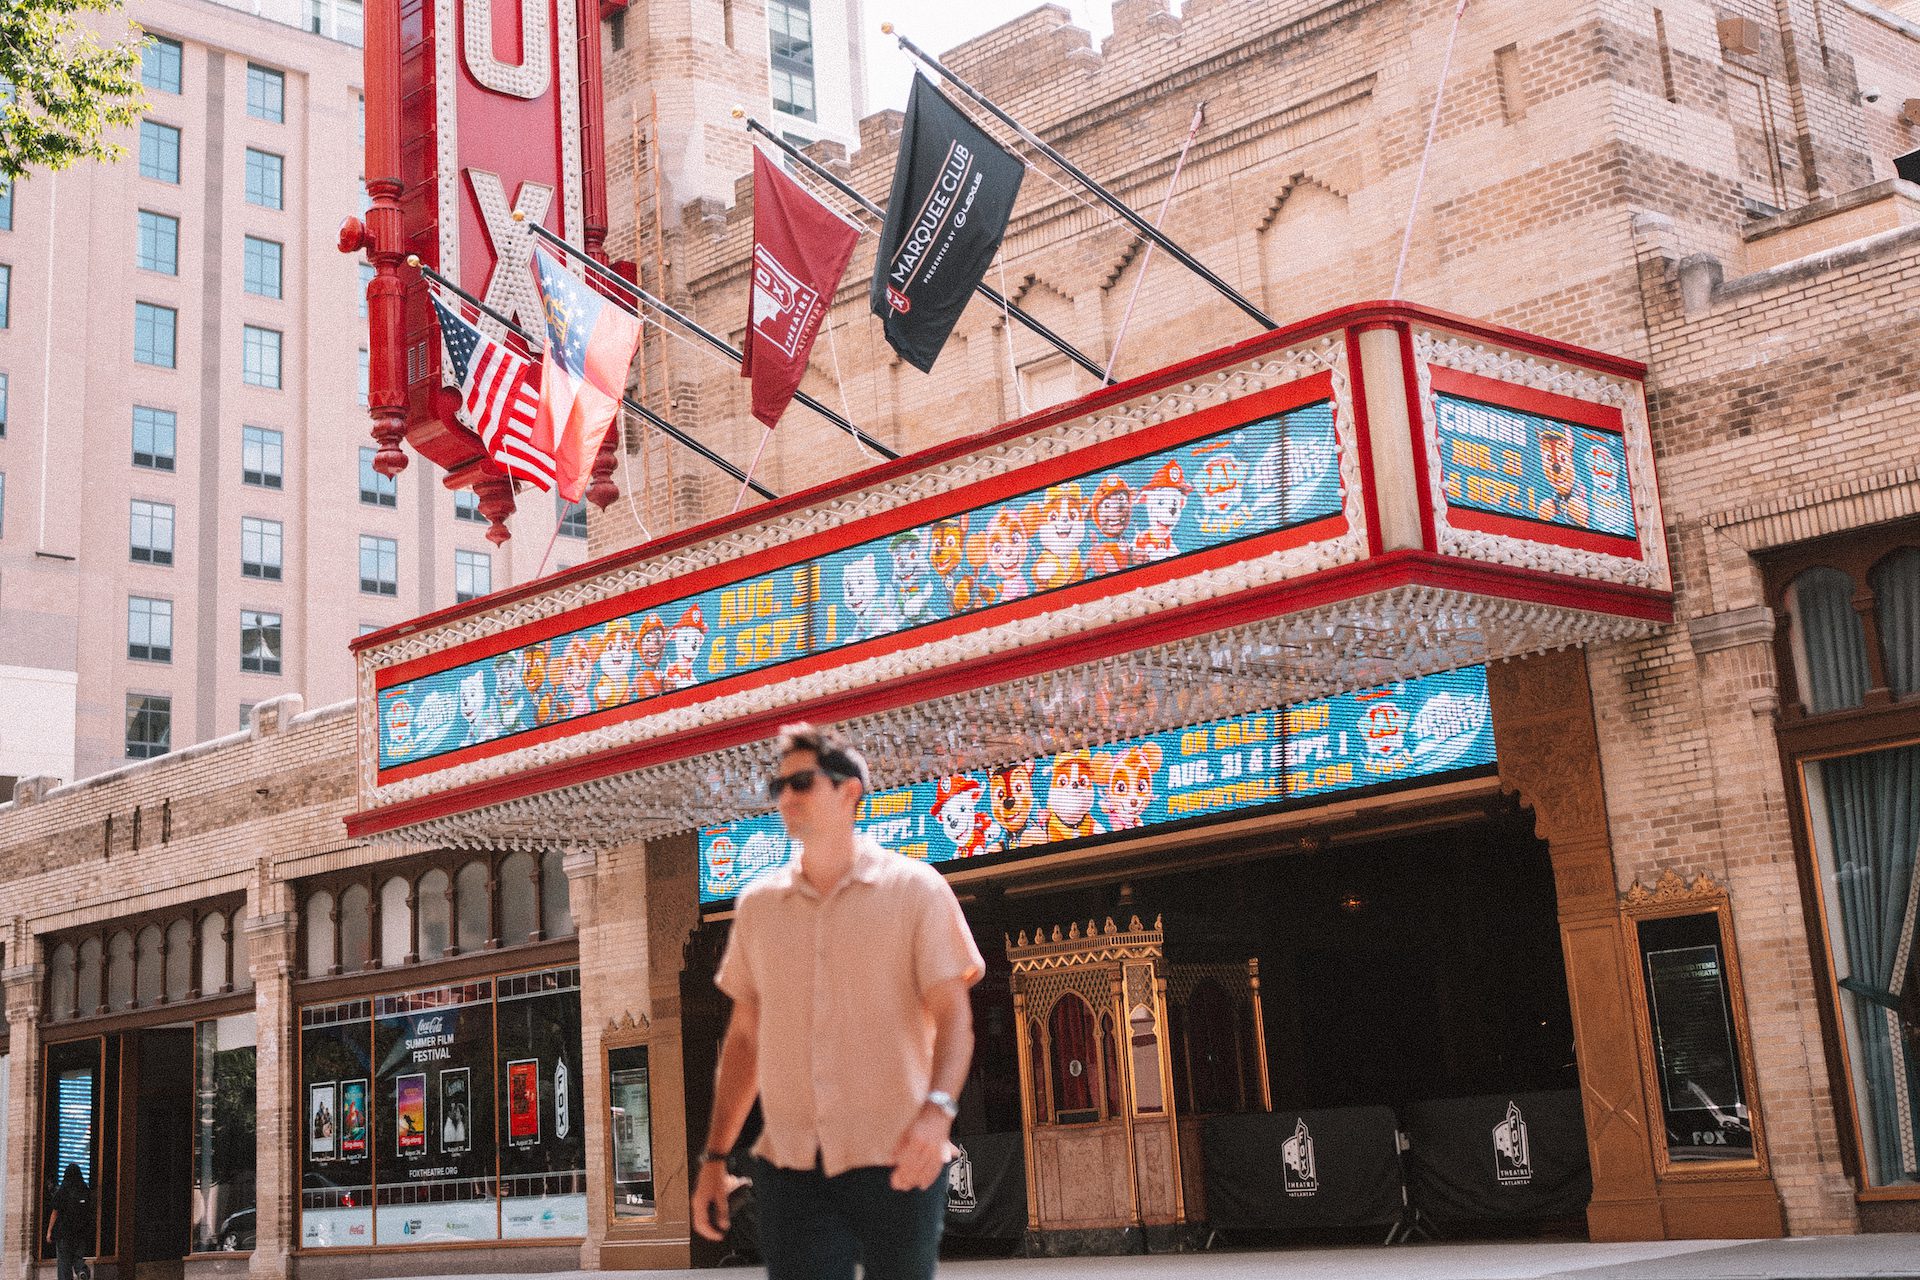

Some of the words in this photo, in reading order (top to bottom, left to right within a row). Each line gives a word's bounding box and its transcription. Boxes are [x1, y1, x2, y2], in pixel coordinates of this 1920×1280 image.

[961, 172, 983, 213] LEXUS
[891, 190, 950, 284] MARQUEE
[941, 144, 969, 192] CLUB
[923, 242, 949, 284] PRESENTED
[948, 230, 956, 241] BY
[756, 267, 785, 301] OX
[785, 292, 811, 348] THEATRE
[798, 306, 822, 351] ATLANTA
[1440, 402, 1526, 446] COMING
[1451, 439, 1497, 472] AUG.
[1502, 450, 1523, 477] 31
[1467, 475, 1522, 510] SEPT.
[718, 579, 782, 629] AUG.
[791, 565, 821, 608] 31
[735, 612, 817, 667] SEPT.
[1181, 729, 1208, 756] ON
[1214, 717, 1268, 750] SALE
[1273, 704, 1330, 737] NOW!
[1168, 759, 1214, 790] AUG.
[1221, 751, 1242, 779] 31
[1270, 734, 1332, 768] SEPT.
[1338, 730, 1347, 755] 1
[869, 790, 913, 818] NOW!
[405, 1036, 436, 1050] SUMMER
[437, 1033, 454, 1046] FILM
[412, 1047, 451, 1063] FESTIVAL
[1298, 1131, 1307, 1171] FOX
[1509, 1115, 1520, 1157] FOX
[1691, 1130, 1727, 1145] FOX
[408, 1166, 458, 1178] FOXTHEATRE.ORG
[1287, 1181, 1315, 1189] THEATRE
[1500, 1168, 1528, 1177] THEATRE
[626, 1193, 644, 1205] FOX
